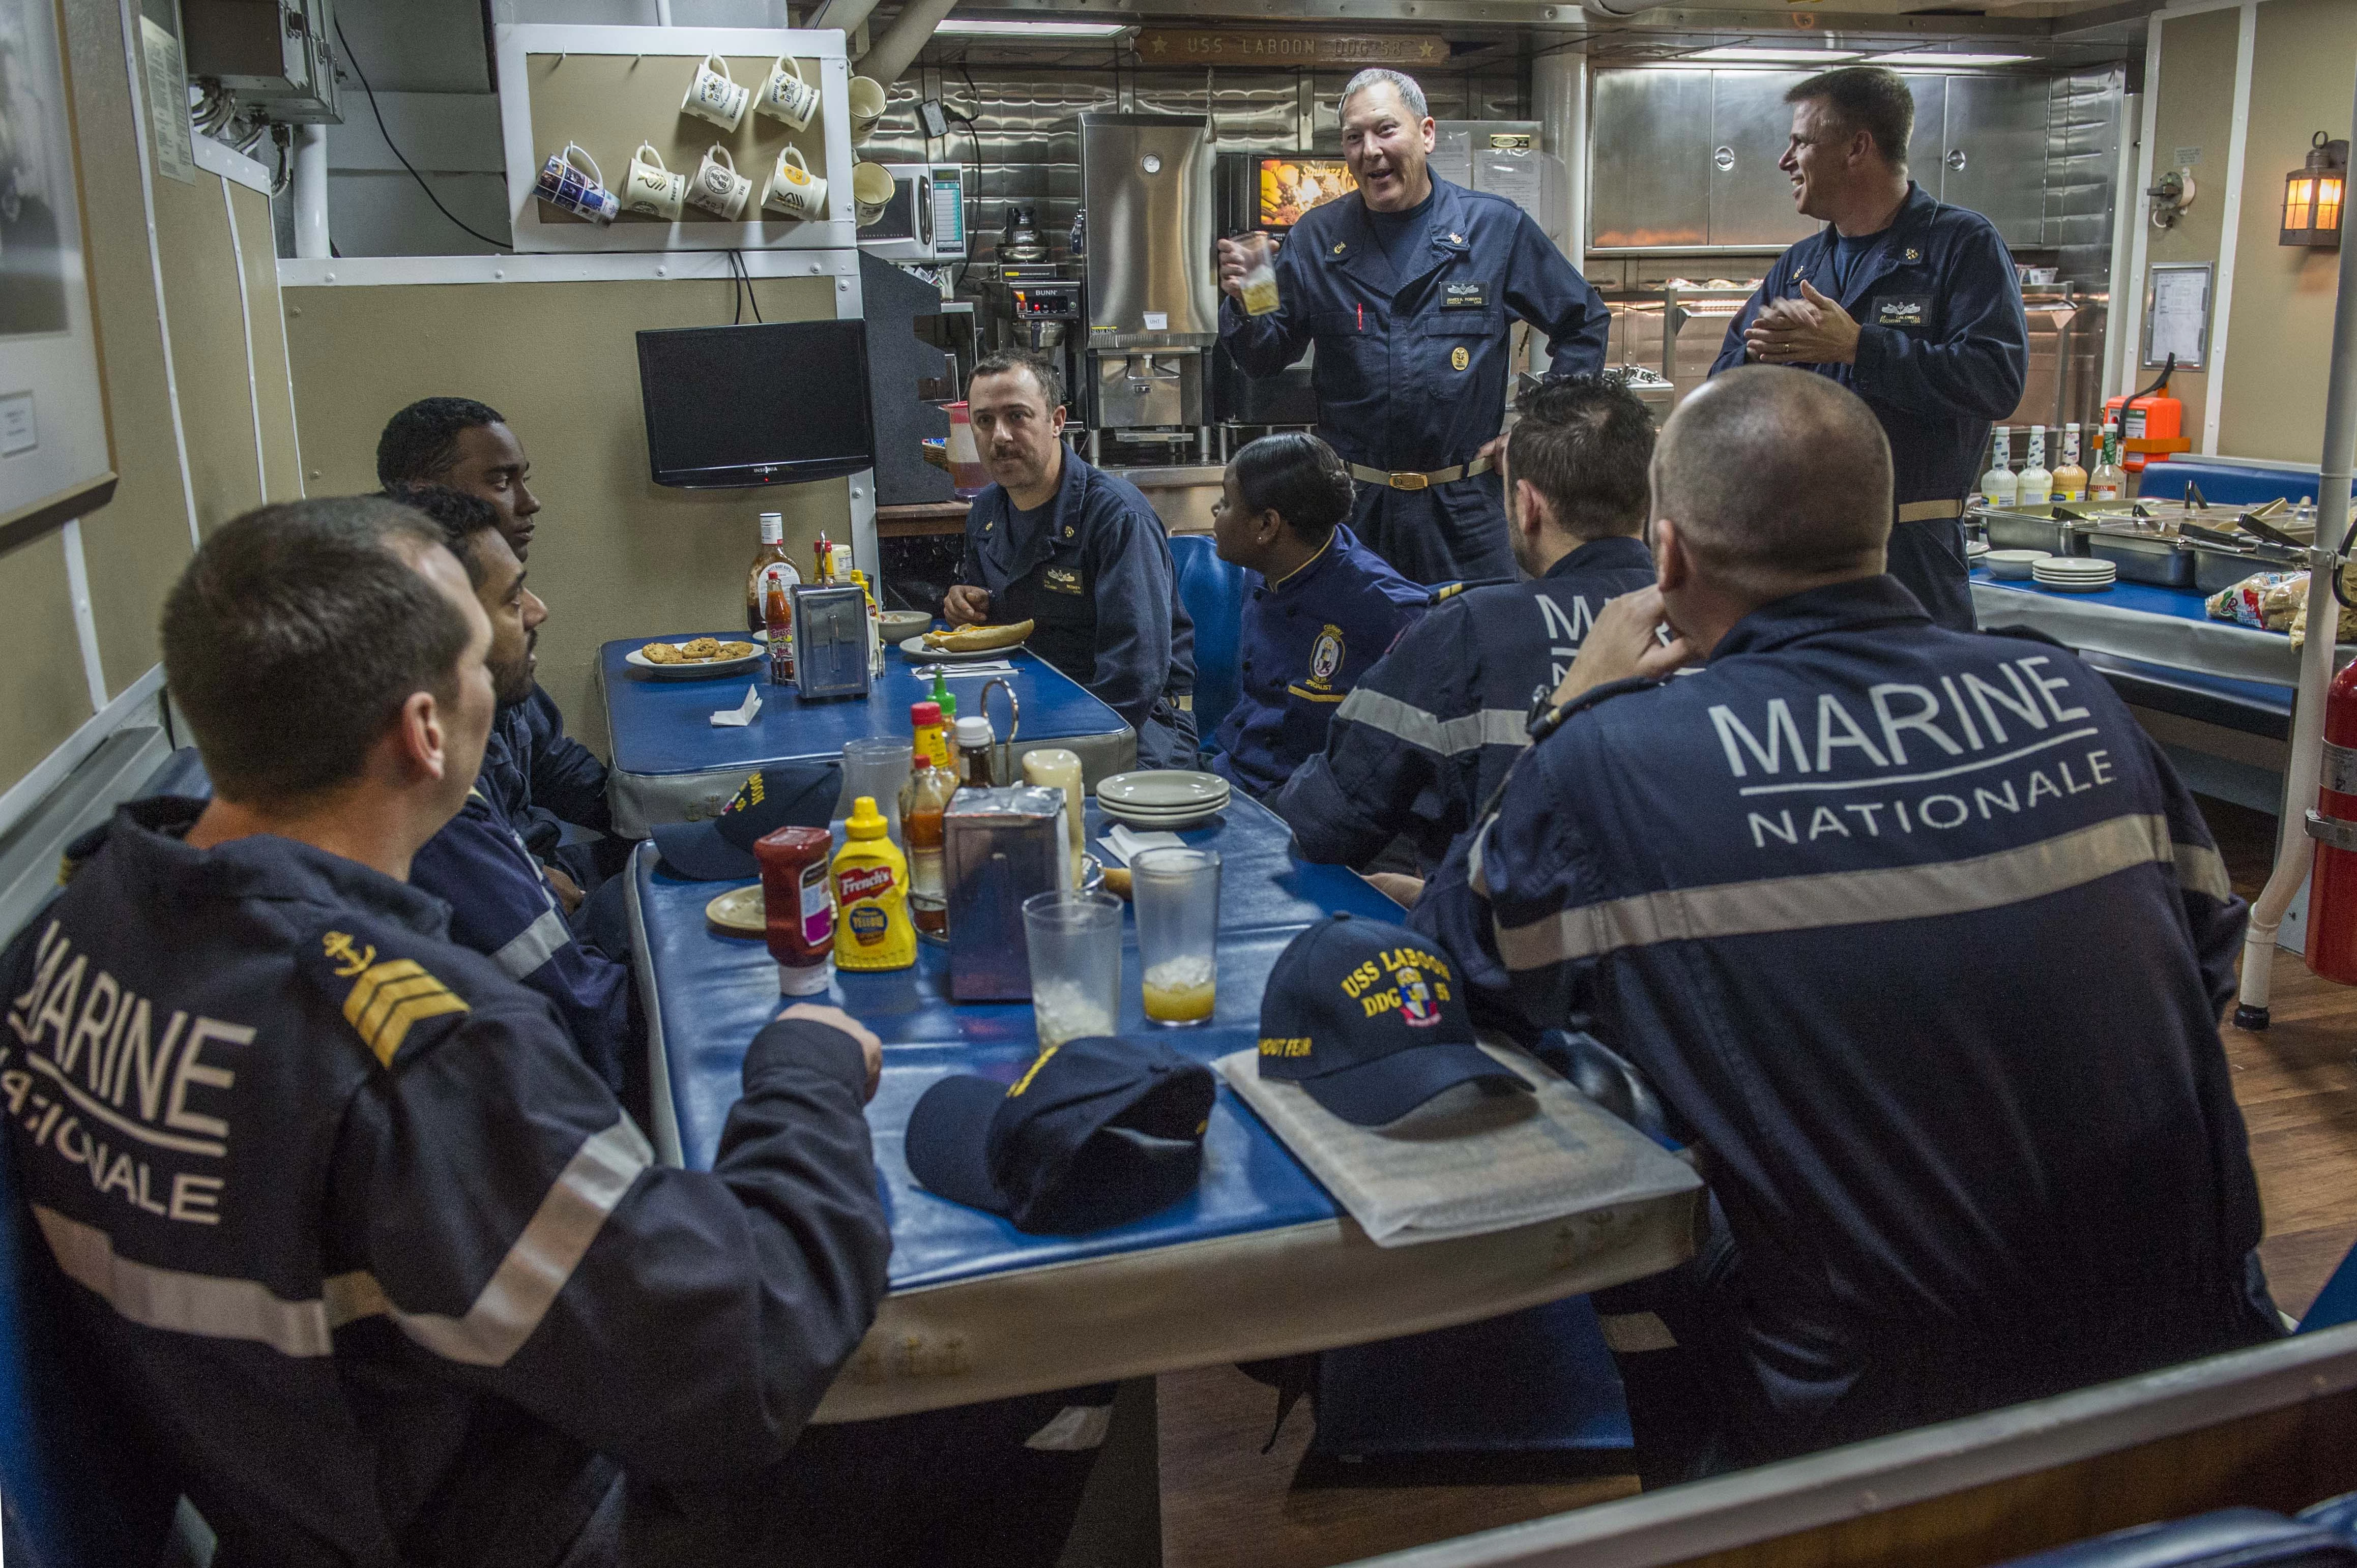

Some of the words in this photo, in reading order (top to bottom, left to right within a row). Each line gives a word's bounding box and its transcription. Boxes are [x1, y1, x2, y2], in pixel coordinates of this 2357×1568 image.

[1188, 38, 1222, 53] USS
[1243, 39, 1315, 54] LABOON
[1305, 679, 1333, 691] SPECIALIST
[1708, 656, 2091, 777] MARINE
[1748, 750, 2116, 848] NATIONALE
[841, 870, 889, 896] French's
[1341, 960, 1380, 998] USS
[1379, 948, 1451, 983] LABOON
[1360, 987, 1403, 1018] DDG
[1285, 1037, 1312, 1057] FEAR
